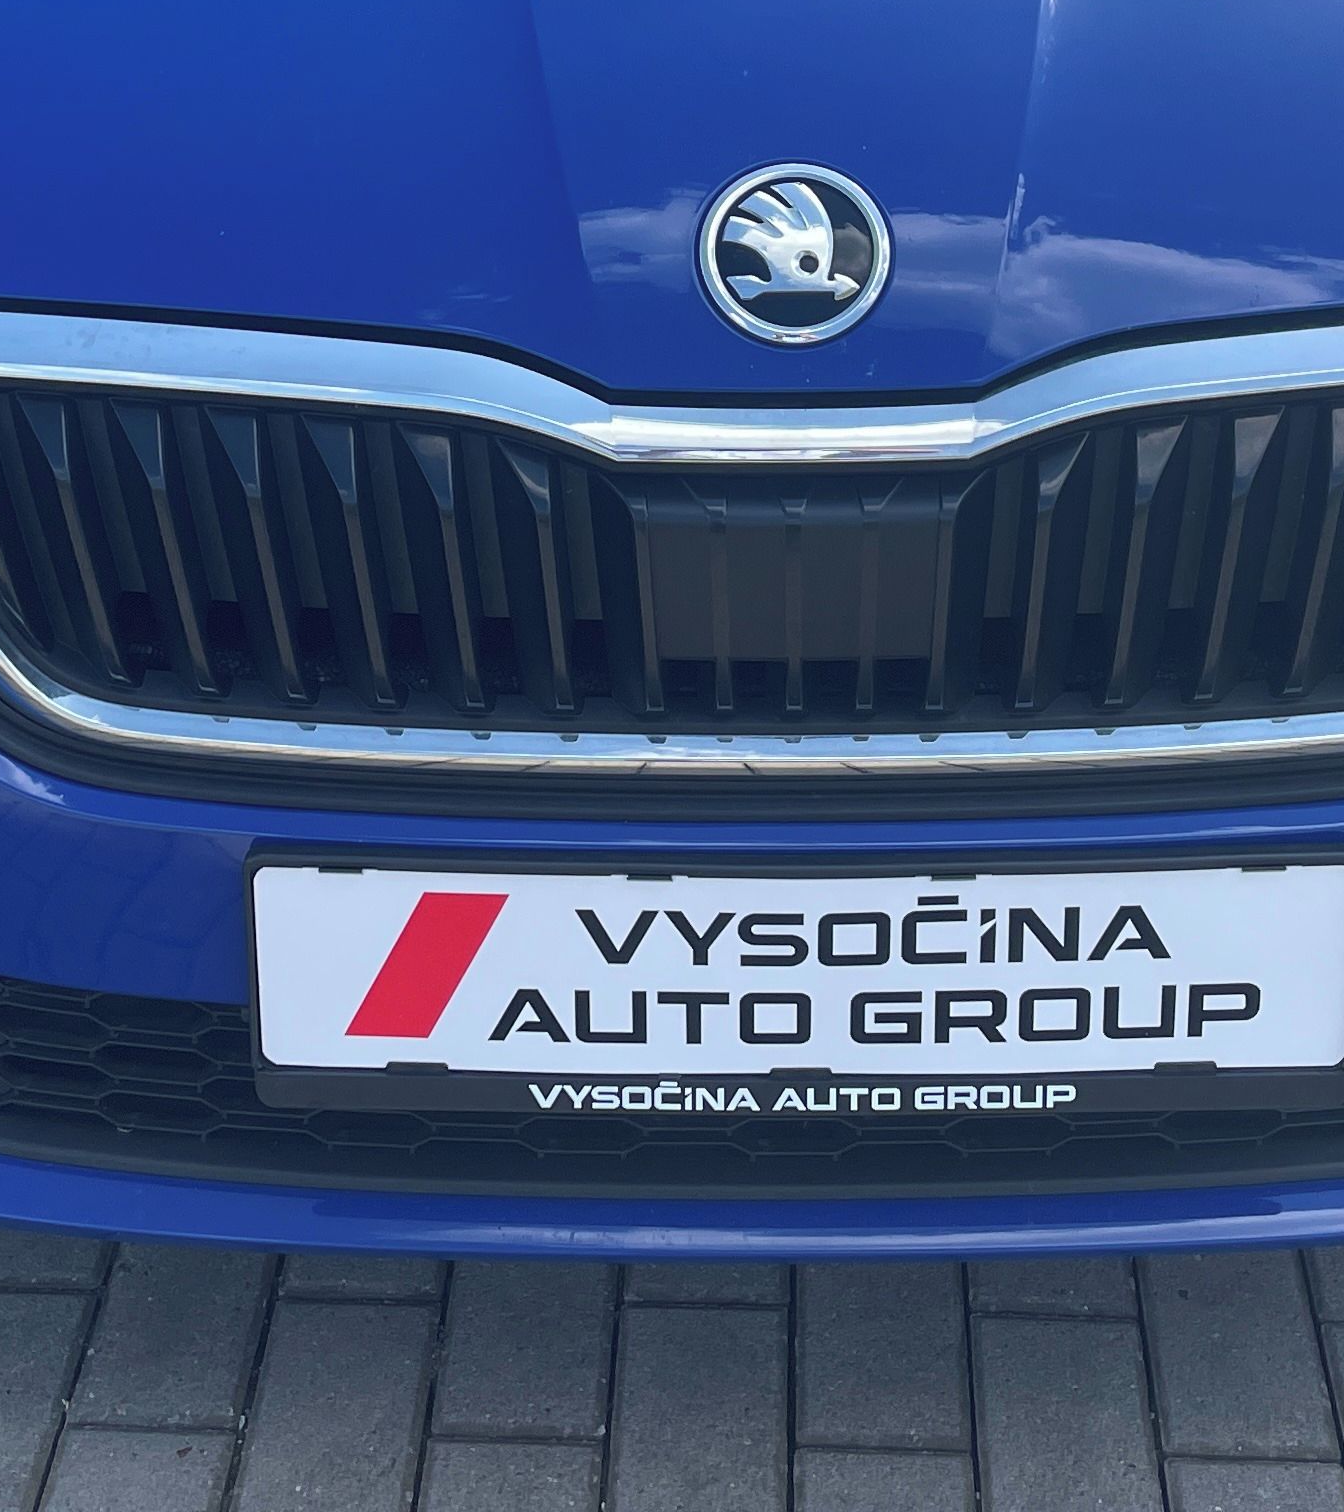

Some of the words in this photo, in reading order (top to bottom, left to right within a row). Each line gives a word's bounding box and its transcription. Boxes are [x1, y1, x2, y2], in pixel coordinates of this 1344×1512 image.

[487, 988, 812, 1045] AUTO
[849, 983, 1261, 1044] GROUP
[771, 1086, 901, 1112] AUTO
[914, 1084, 1078, 1111] GROUP
